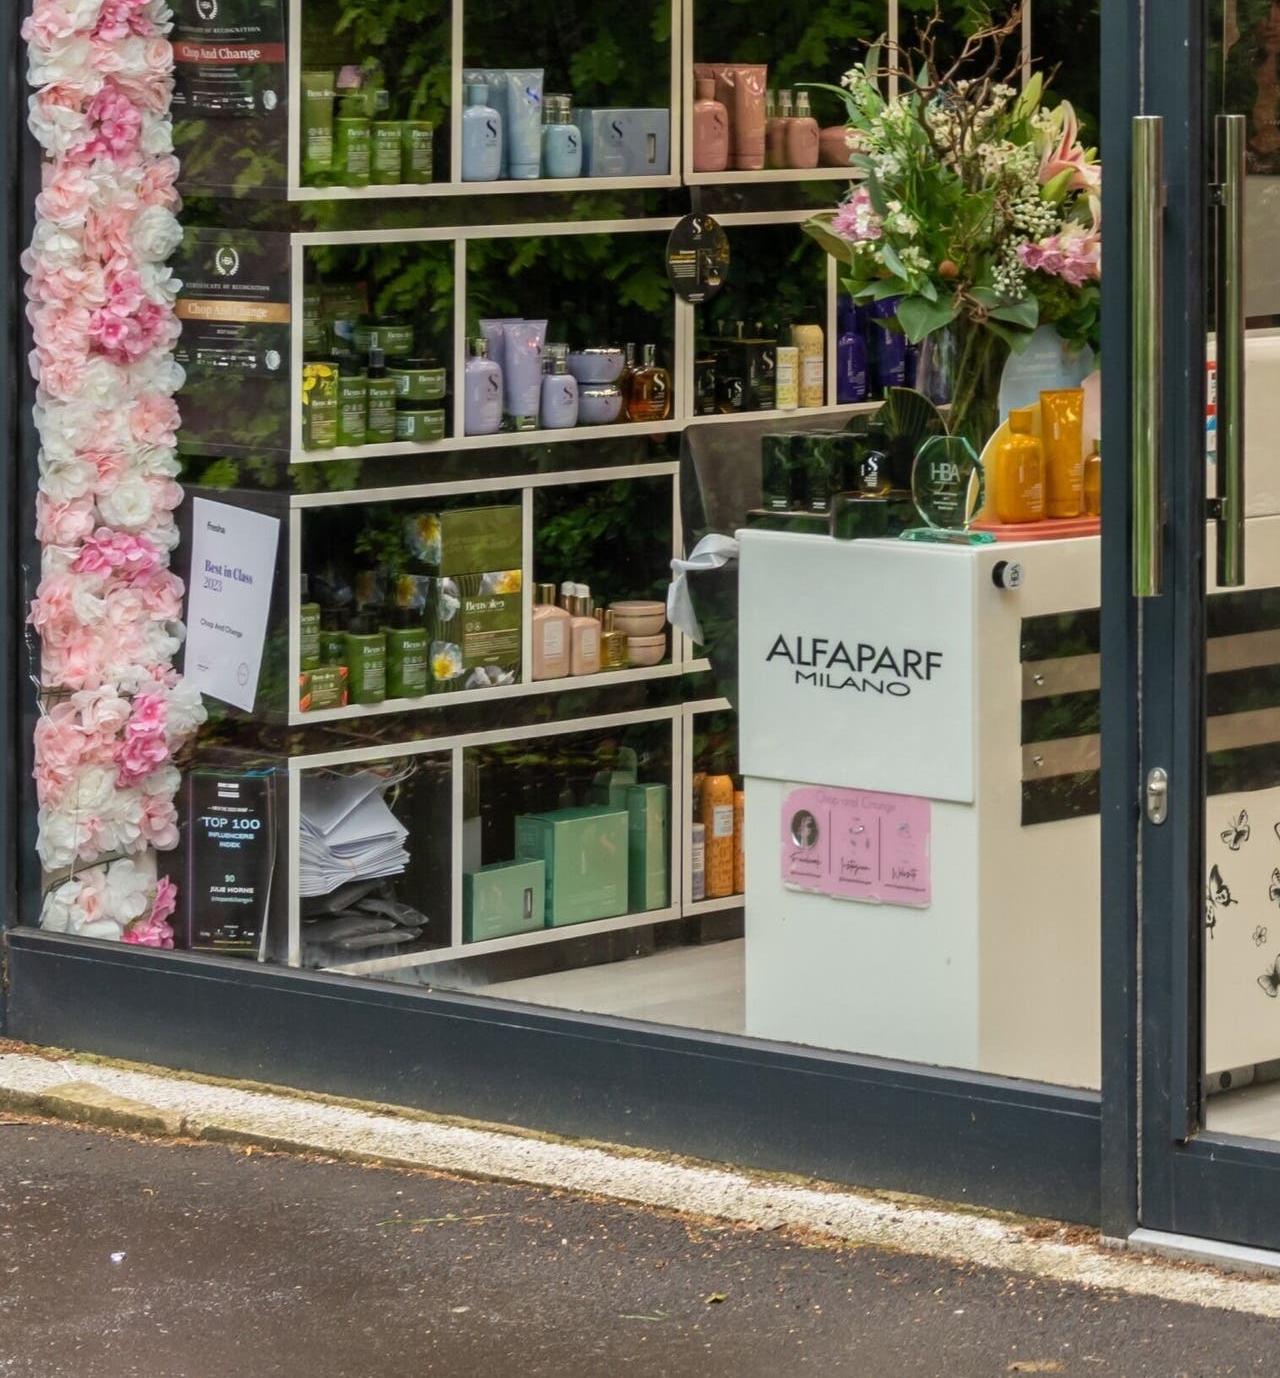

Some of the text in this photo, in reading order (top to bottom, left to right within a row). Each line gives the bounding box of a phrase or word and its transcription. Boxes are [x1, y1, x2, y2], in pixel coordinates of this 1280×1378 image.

[200, 48, 217, 60] And
[218, 47, 261, 62] Change
[188, 302, 213, 318] Chop
[930, 462, 960, 483] HBA
[204, 559, 254, 586] Best in Class
[225, 625, 243, 639] Change
[765, 633, 943, 681] ALFAPARF
[795, 670, 911, 697] MILANO
[202, 816, 261, 830] TOP 100
